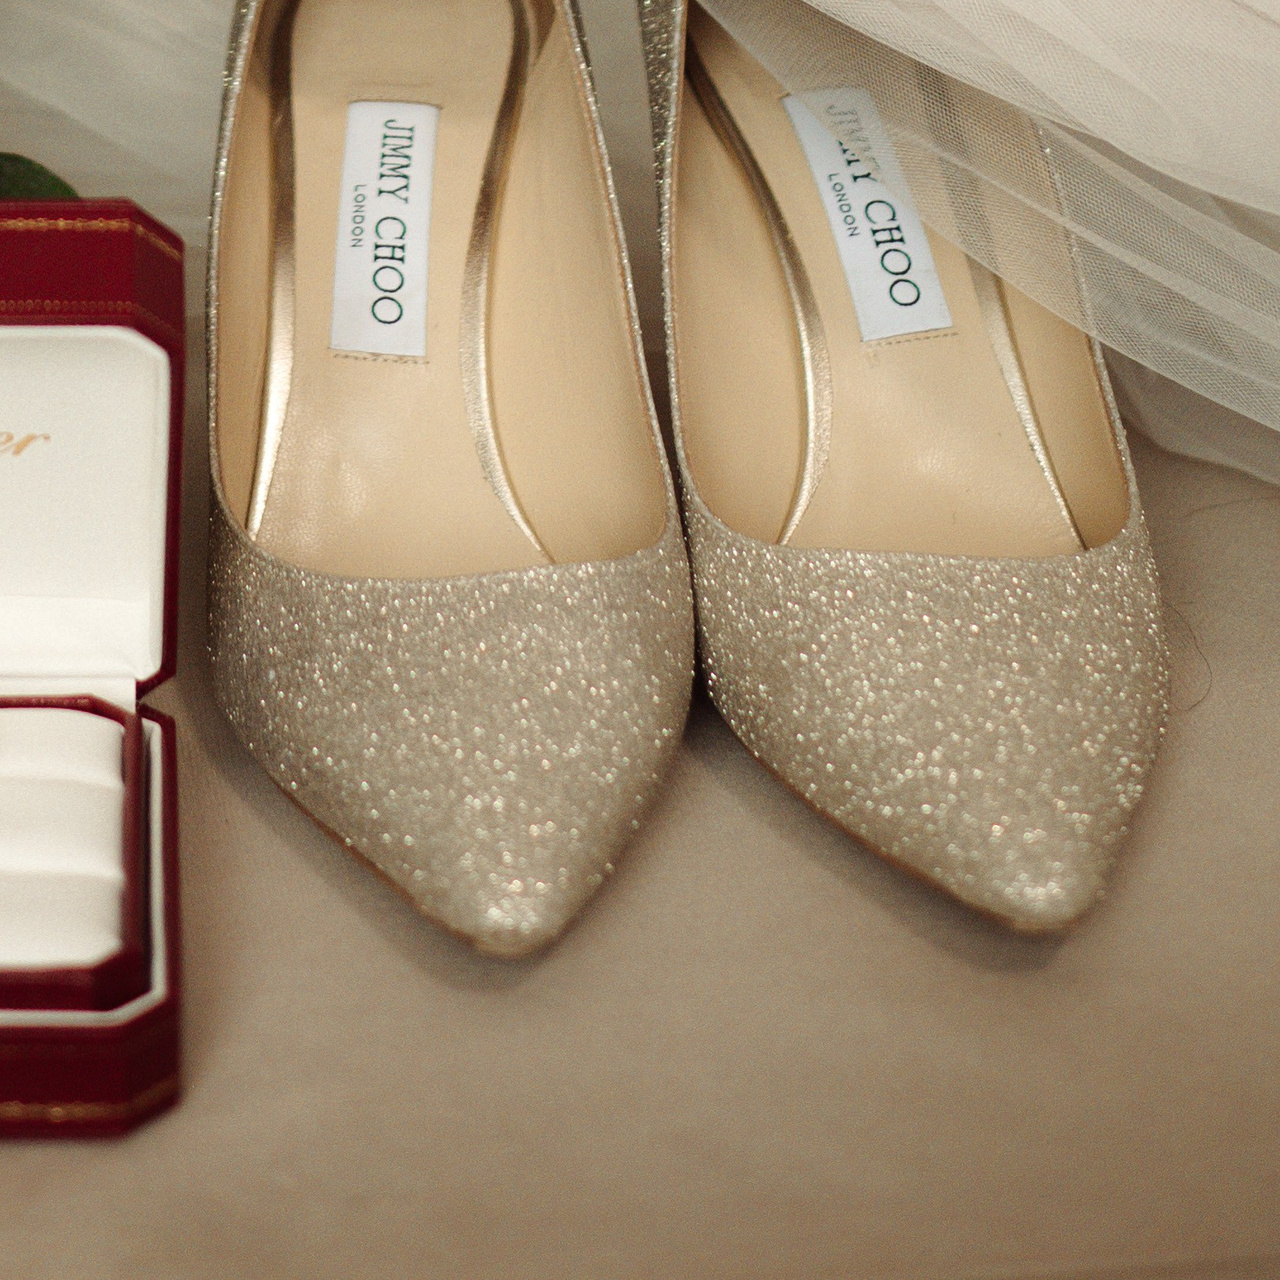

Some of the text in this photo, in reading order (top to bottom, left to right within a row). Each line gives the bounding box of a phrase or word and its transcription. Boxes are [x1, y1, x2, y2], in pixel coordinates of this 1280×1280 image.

[351, 184, 368, 248] LONDON
[371, 119, 415, 324] JIMMY CHOO
[828, 173, 860, 238] LONDON
[864, 200, 920, 307] CHOO
